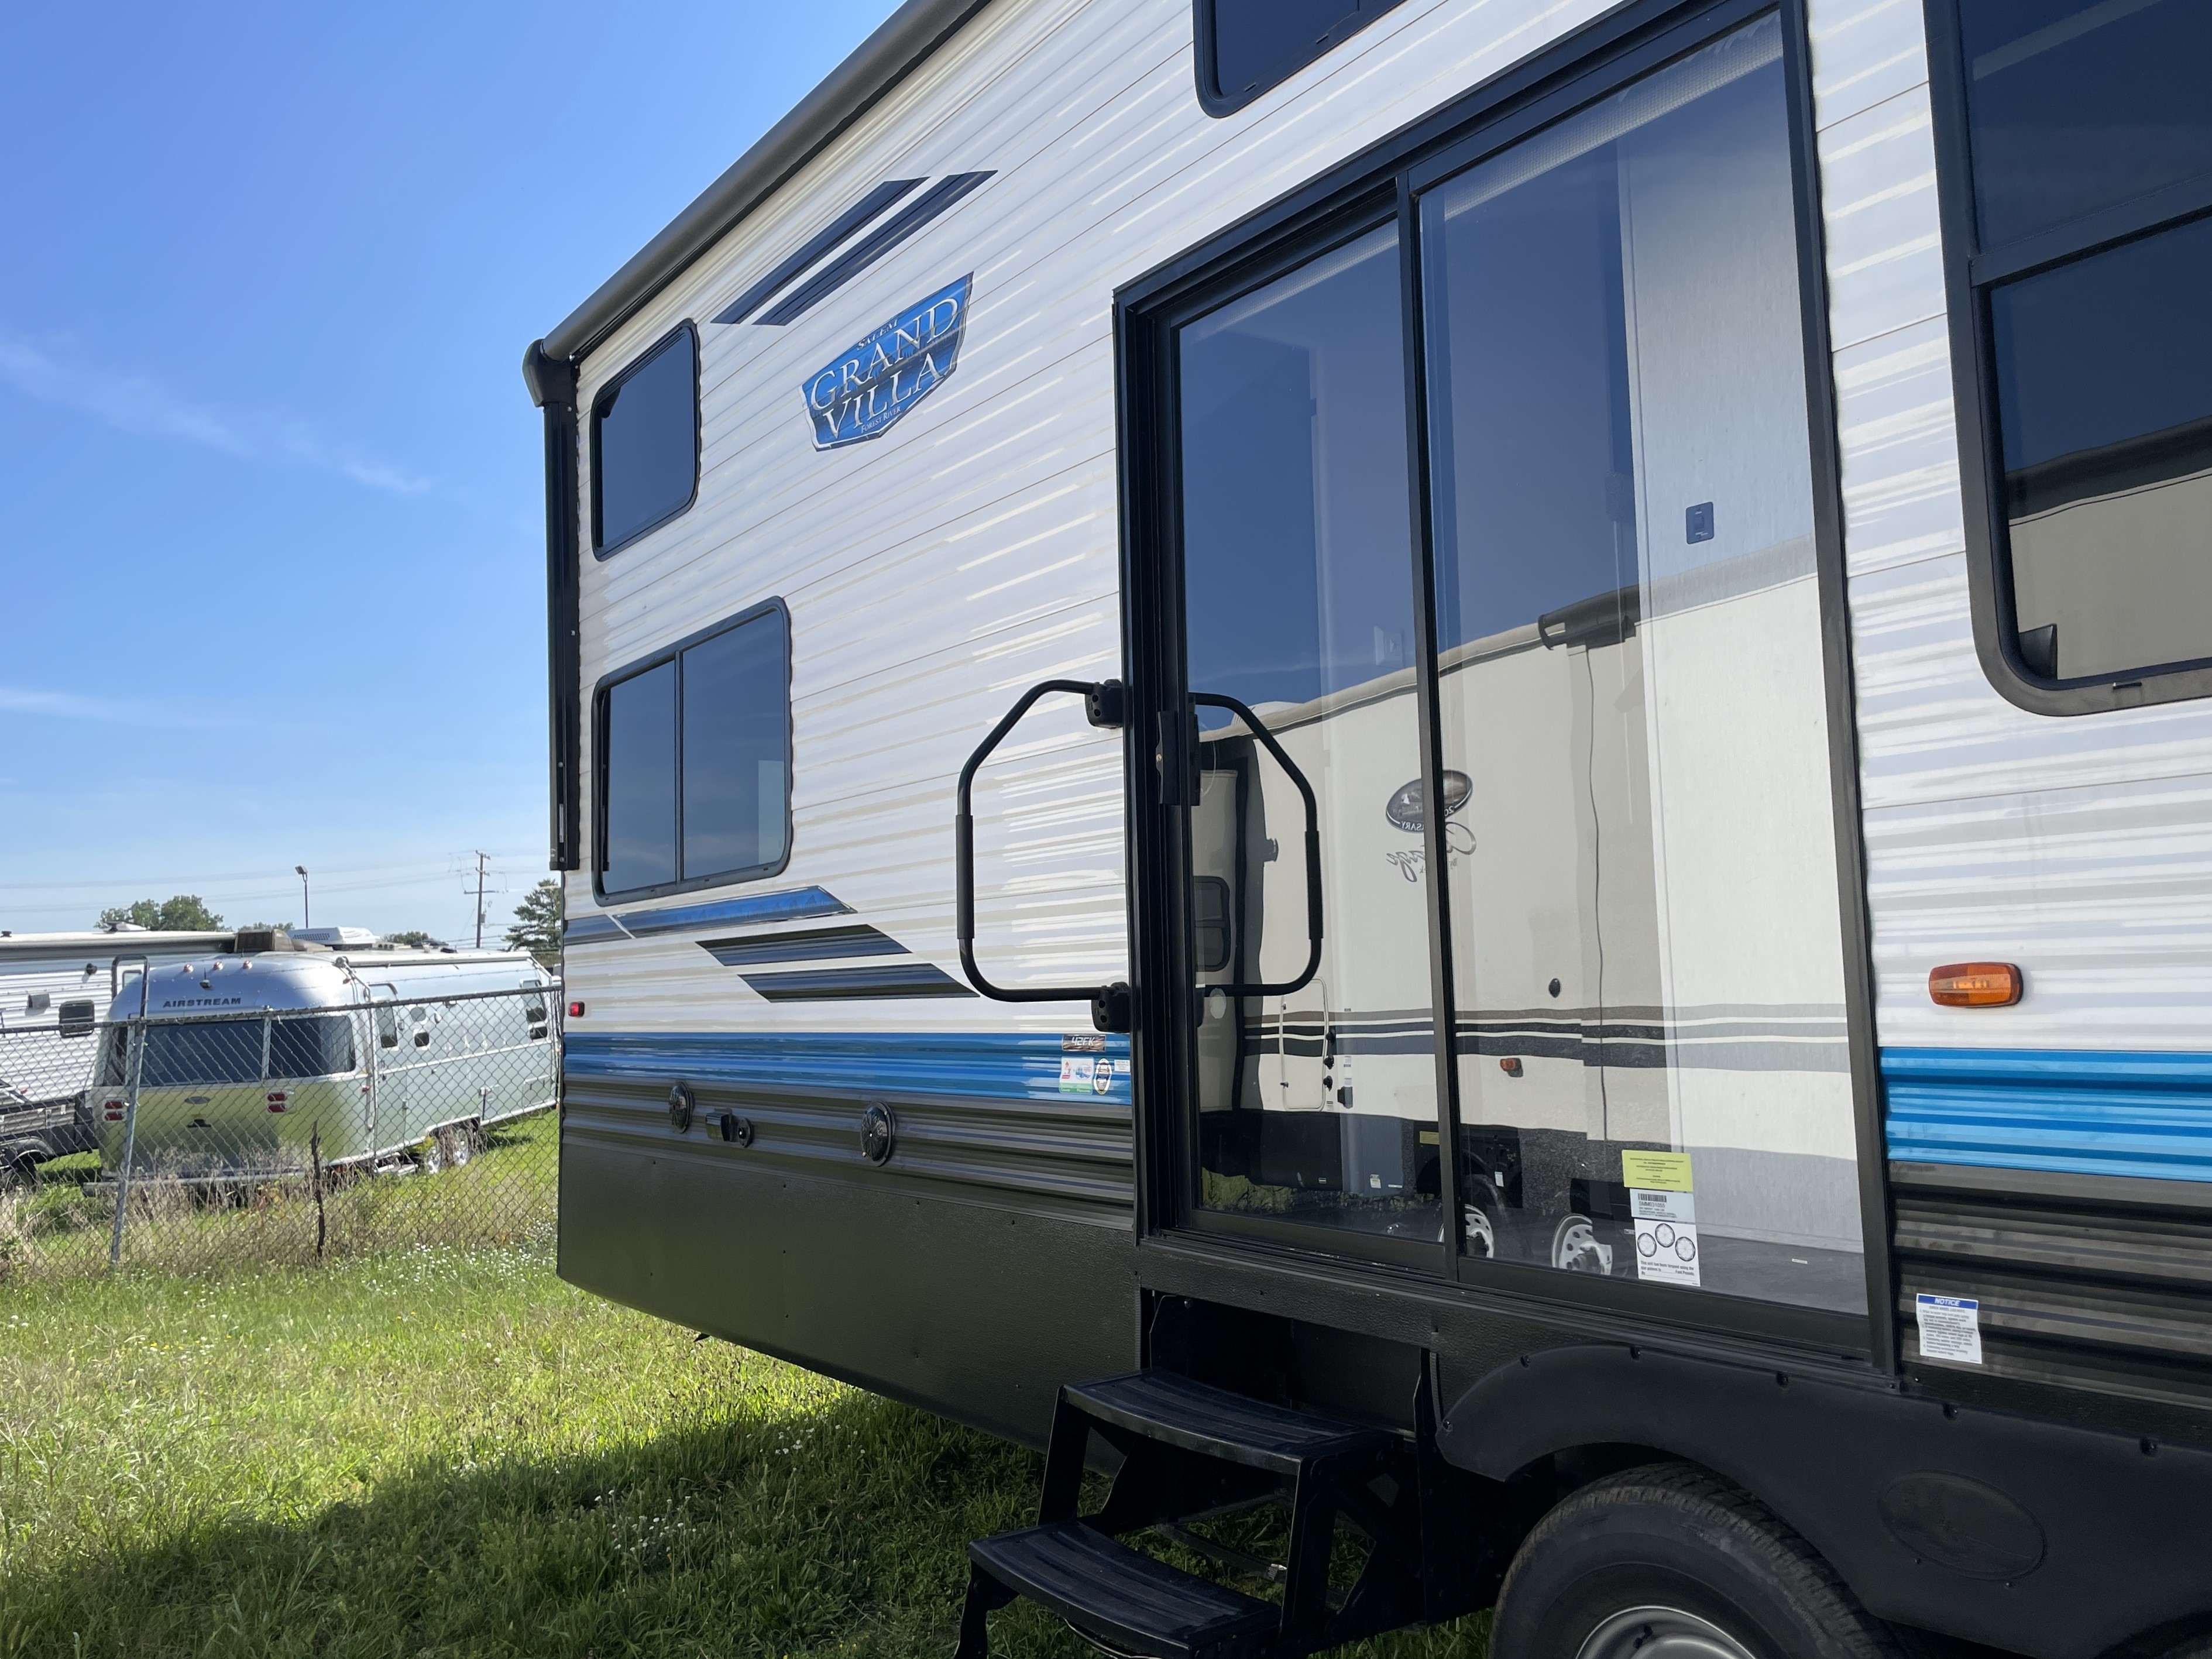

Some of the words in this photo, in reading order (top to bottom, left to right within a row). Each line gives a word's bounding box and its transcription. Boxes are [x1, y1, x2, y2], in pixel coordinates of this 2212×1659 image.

[857, 319, 899, 351] SALEM
[810, 297, 959, 410] GRAND
[823, 352, 946, 439] VILLA
[861, 418, 882, 434] FOREST
[883, 406, 901, 421] RIVER
[163, 997, 241, 1008] AIRSTREAM
[1071, 1036, 1095, 1046] 42FK
[1935, 1297, 1960, 1307] NOTICE
